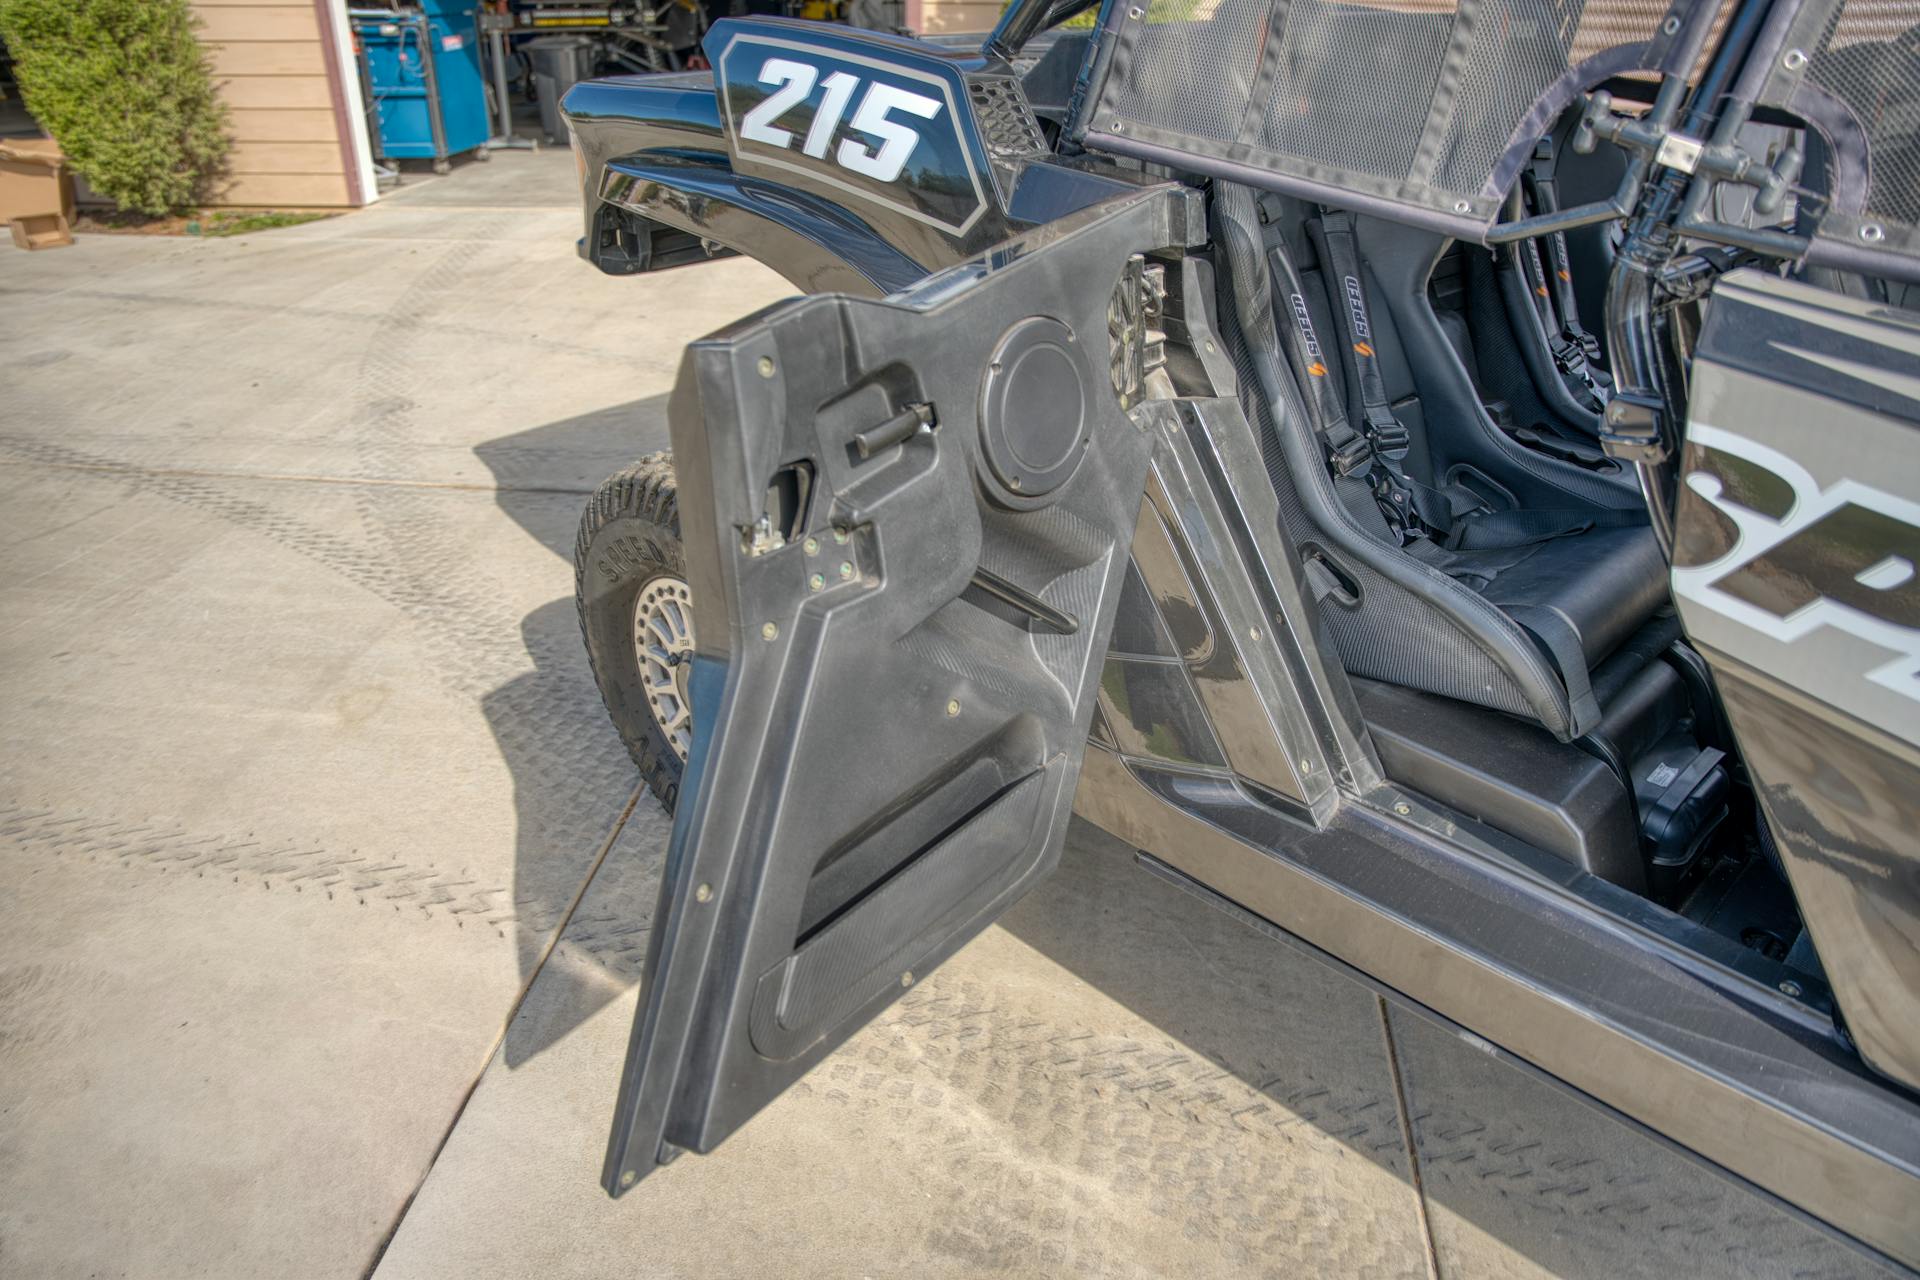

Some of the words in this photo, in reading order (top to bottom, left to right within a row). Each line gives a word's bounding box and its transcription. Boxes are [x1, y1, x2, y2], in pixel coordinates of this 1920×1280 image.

[740, 57, 944, 183] 215
[1290, 293, 1321, 357] SPEED
[1345, 275, 1371, 338] SPEED
[598, 535, 668, 582] SPEED
